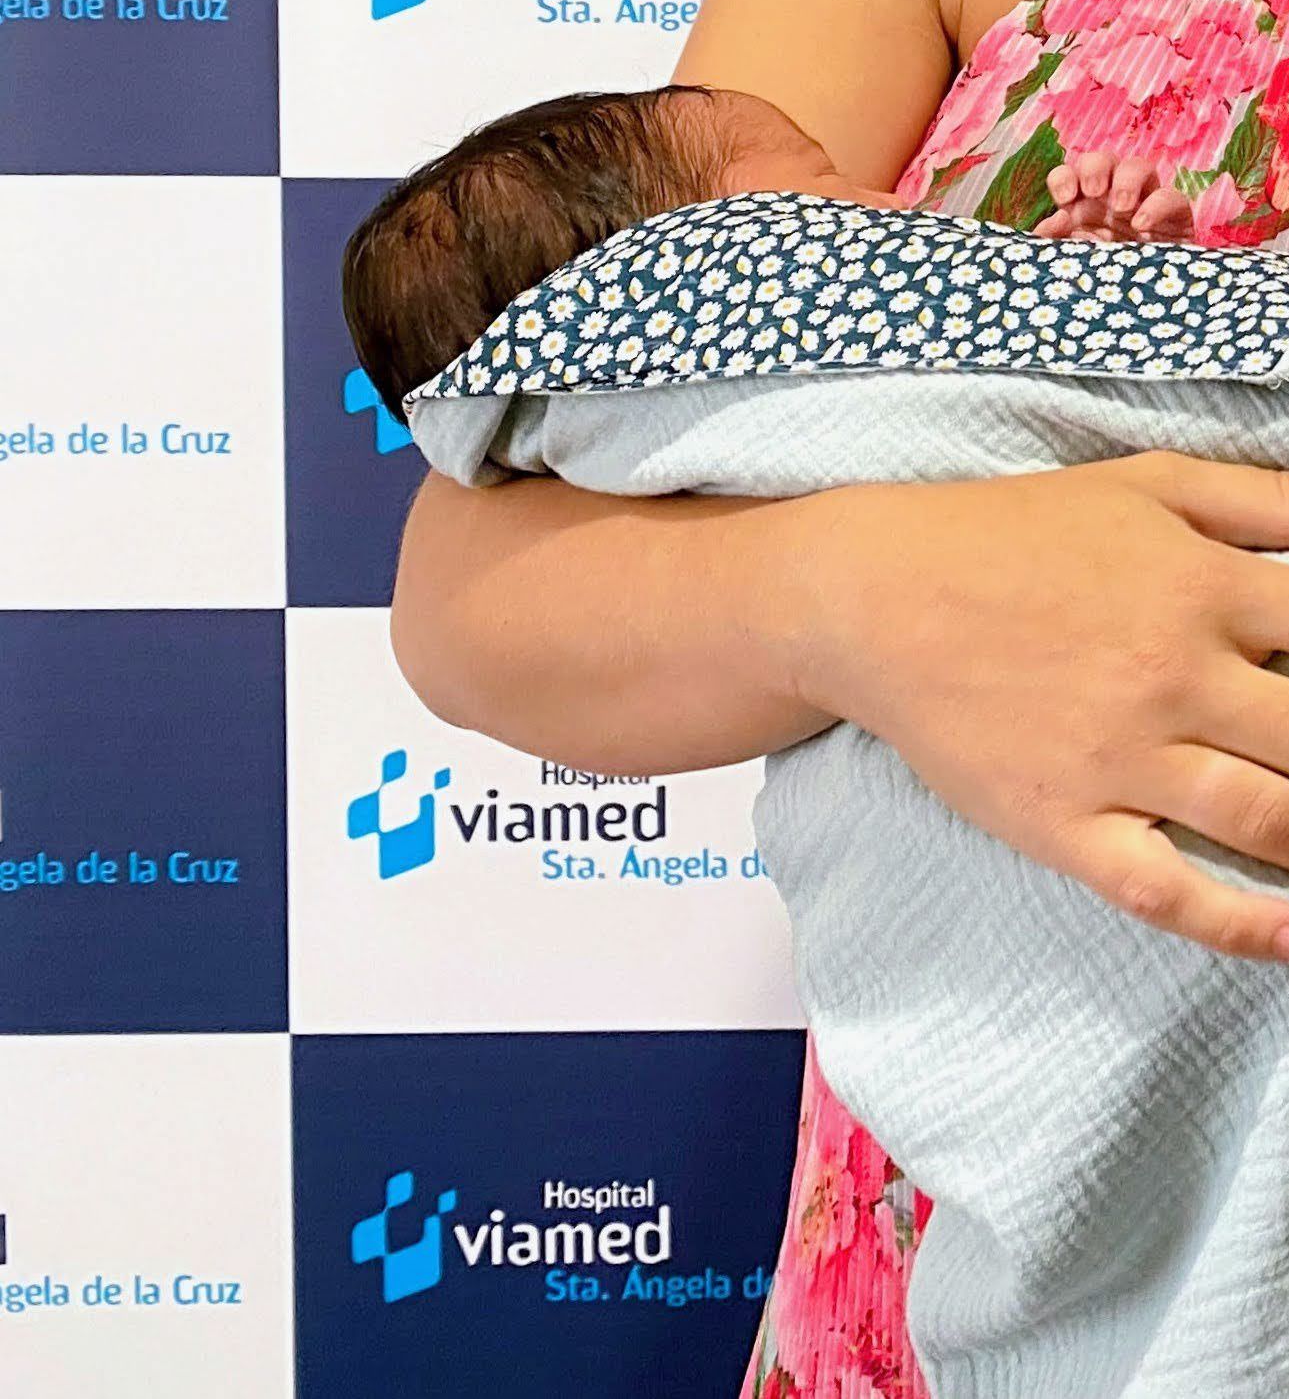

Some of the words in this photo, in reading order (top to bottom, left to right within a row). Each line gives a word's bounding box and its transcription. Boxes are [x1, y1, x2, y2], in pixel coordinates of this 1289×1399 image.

[67, 424, 109, 454] de
[121, 424, 149, 455] la
[160, 422, 231, 456] Cruz
[450, 785, 666, 843] viamed
[76, 853, 117, 883] de
[129, 853, 158, 883] la
[167, 852, 238, 884] Cruz
[541, 848, 606, 881] Sta.
[620, 845, 729, 887] Ángela
[544, 1178, 654, 1214] Hospital
[453, 1204, 670, 1266] viamed
[82, 1275, 122, 1306] de
[134, 1279, 161, 1306] la
[172, 1274, 241, 1306] Cruz
[545, 1269, 610, 1301] Sta.
[622, 1265, 731, 1307] Ángela
